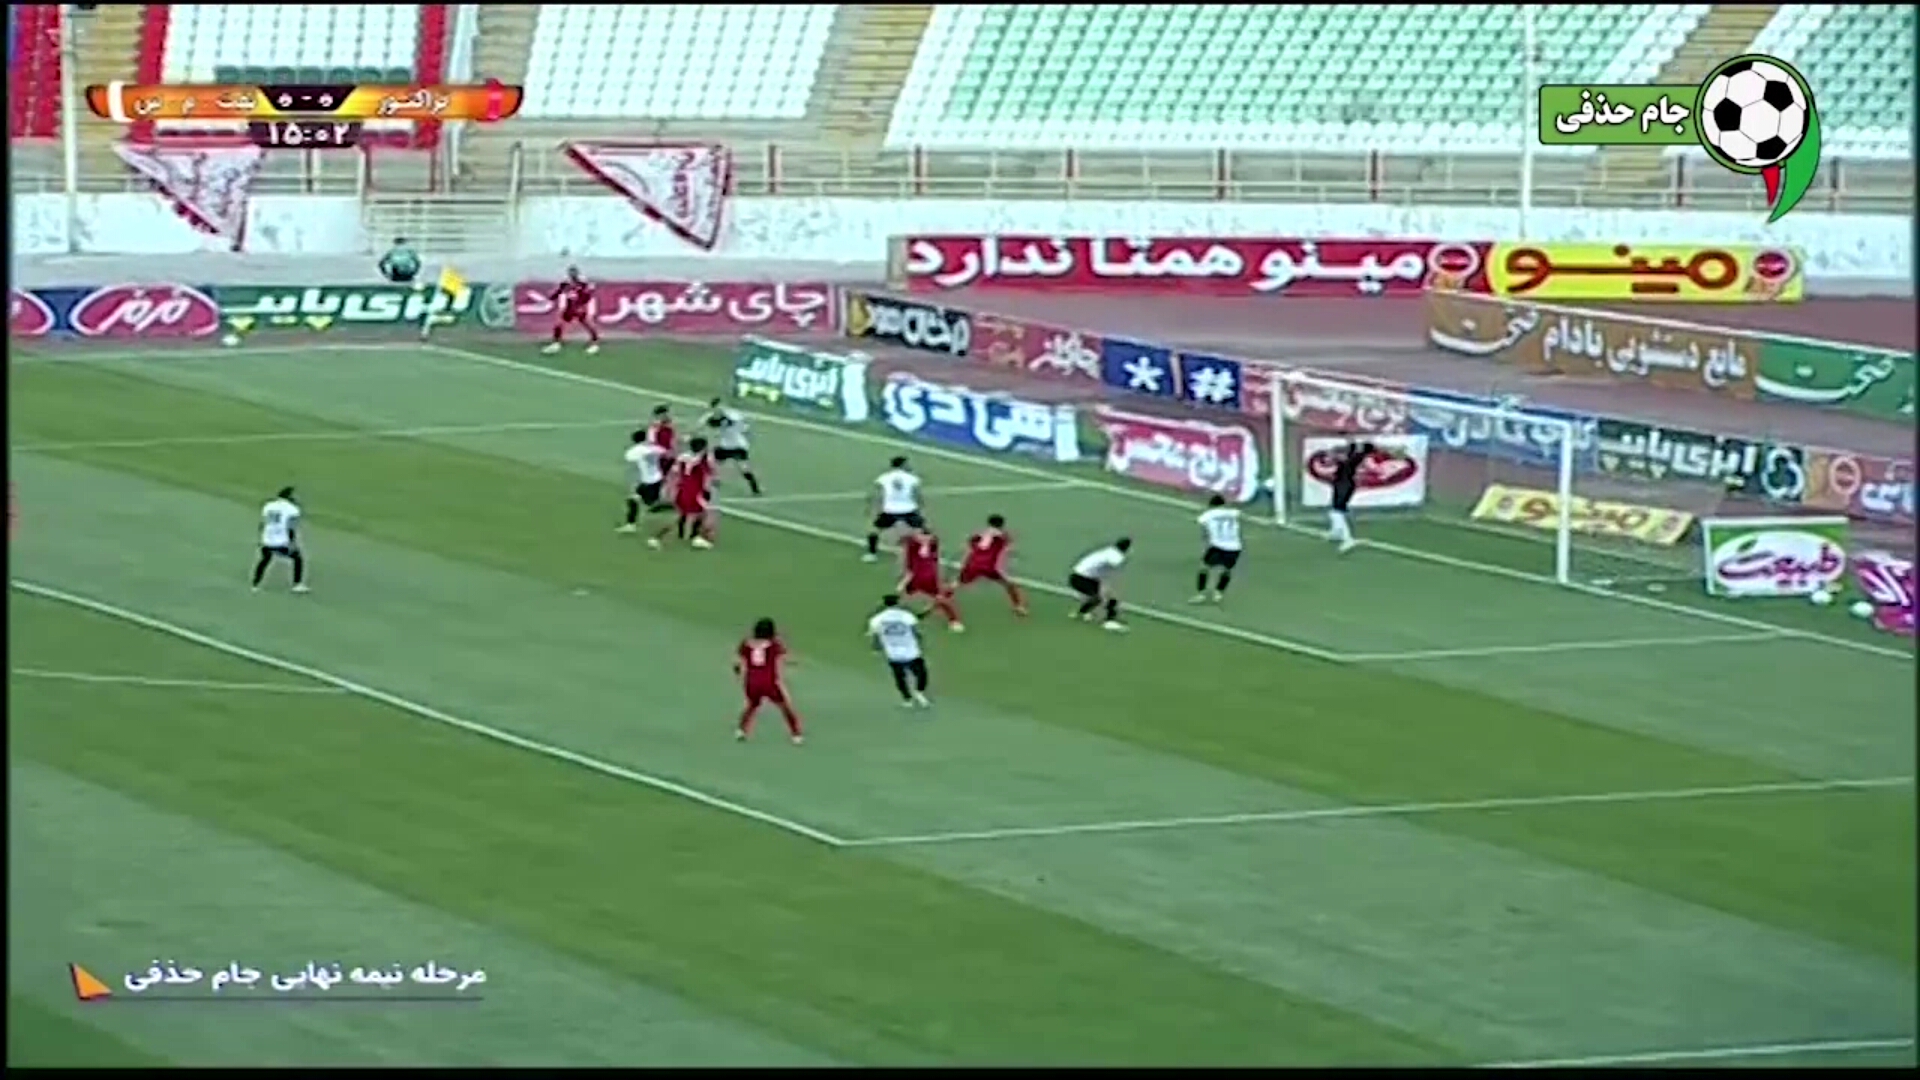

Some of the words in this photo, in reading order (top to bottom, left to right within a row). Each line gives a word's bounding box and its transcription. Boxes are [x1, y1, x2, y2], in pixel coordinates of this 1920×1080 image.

[906, 235, 1077, 287] ندارد
[1089, 235, 1243, 279] همتا
[1251, 238, 1424, 293] مینو
[1504, 243, 1741, 295] مینو
[727, 281, 827, 326] چای
[1543, 315, 1604, 368] بادام
[1702, 337, 1747, 388] مایع
